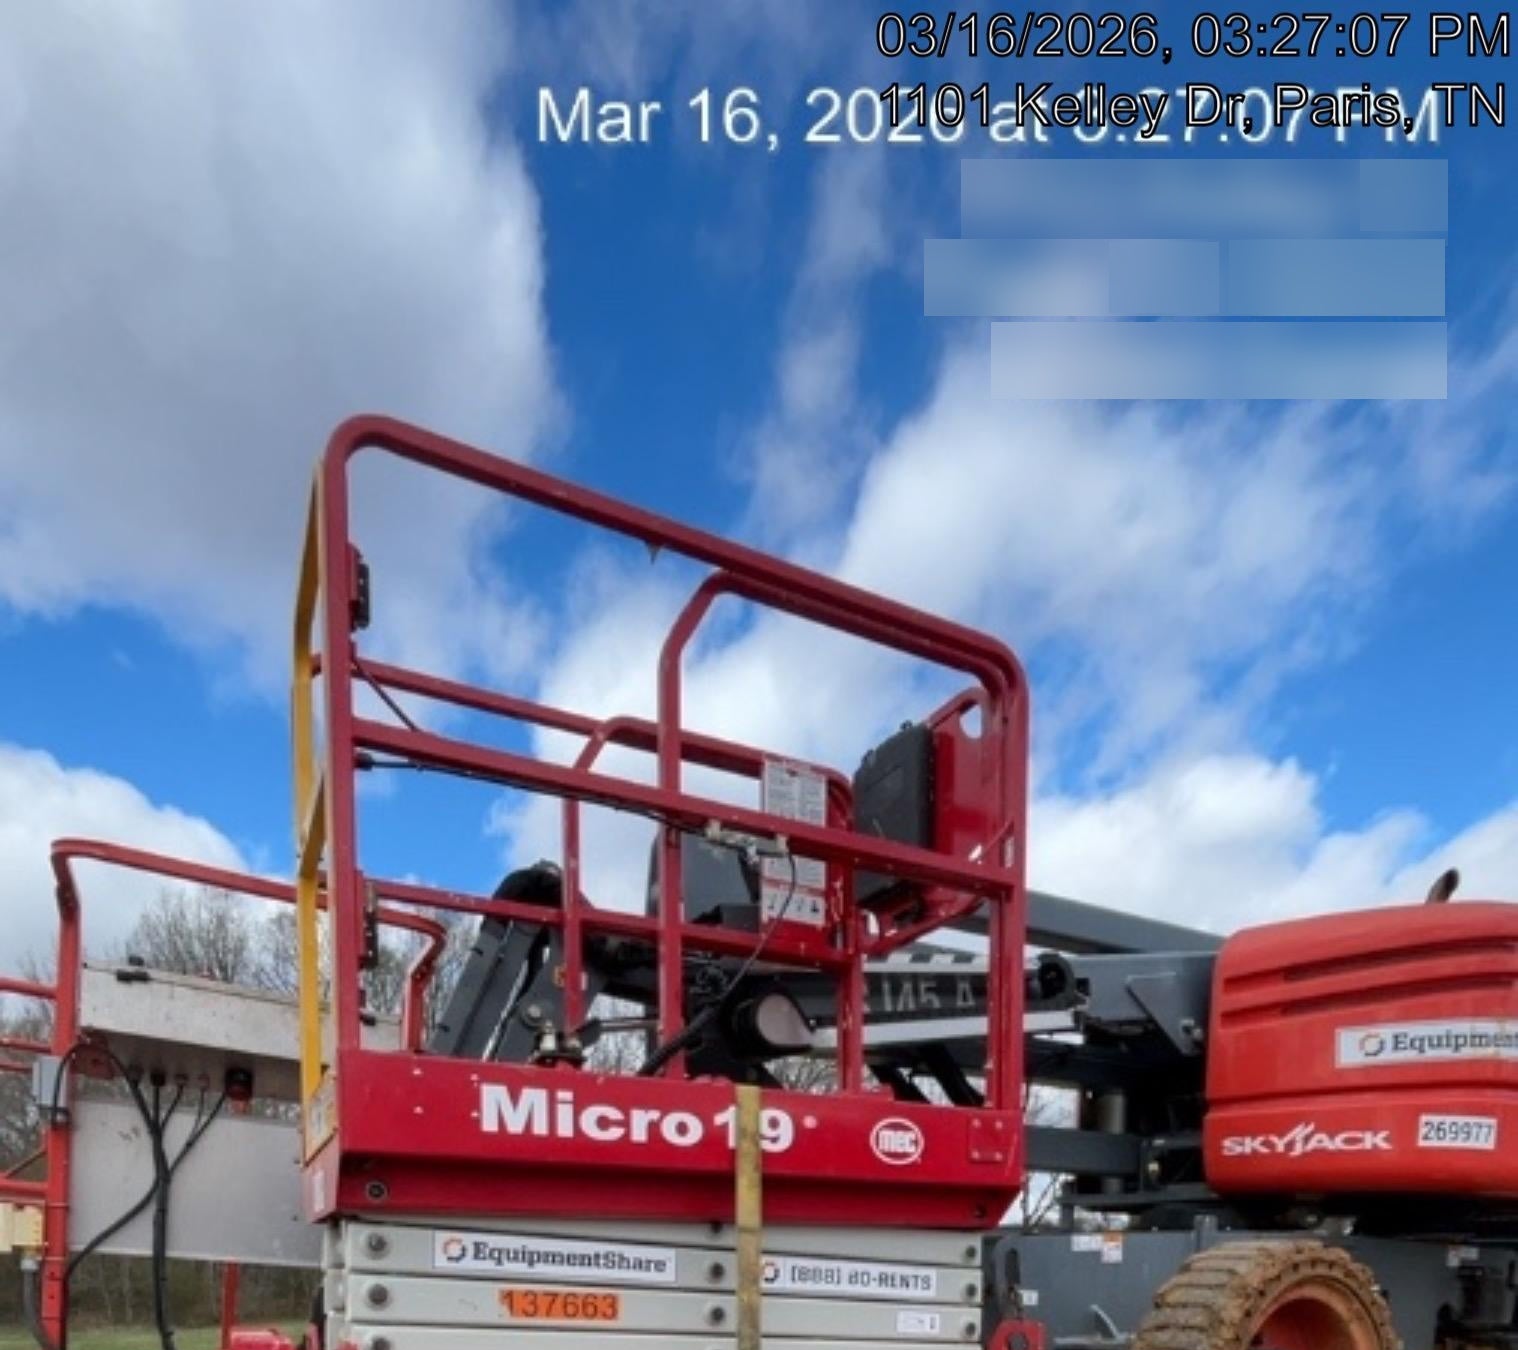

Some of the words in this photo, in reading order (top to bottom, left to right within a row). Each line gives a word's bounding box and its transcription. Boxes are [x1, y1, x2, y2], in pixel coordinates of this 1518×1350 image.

[1222, 1122, 1393, 1157] SKYJACK
[1421, 1120, 1494, 1144] 269977
[472, 1240, 668, 1273] EquipmentShare
[502, 1290, 619, 1321] 137663
